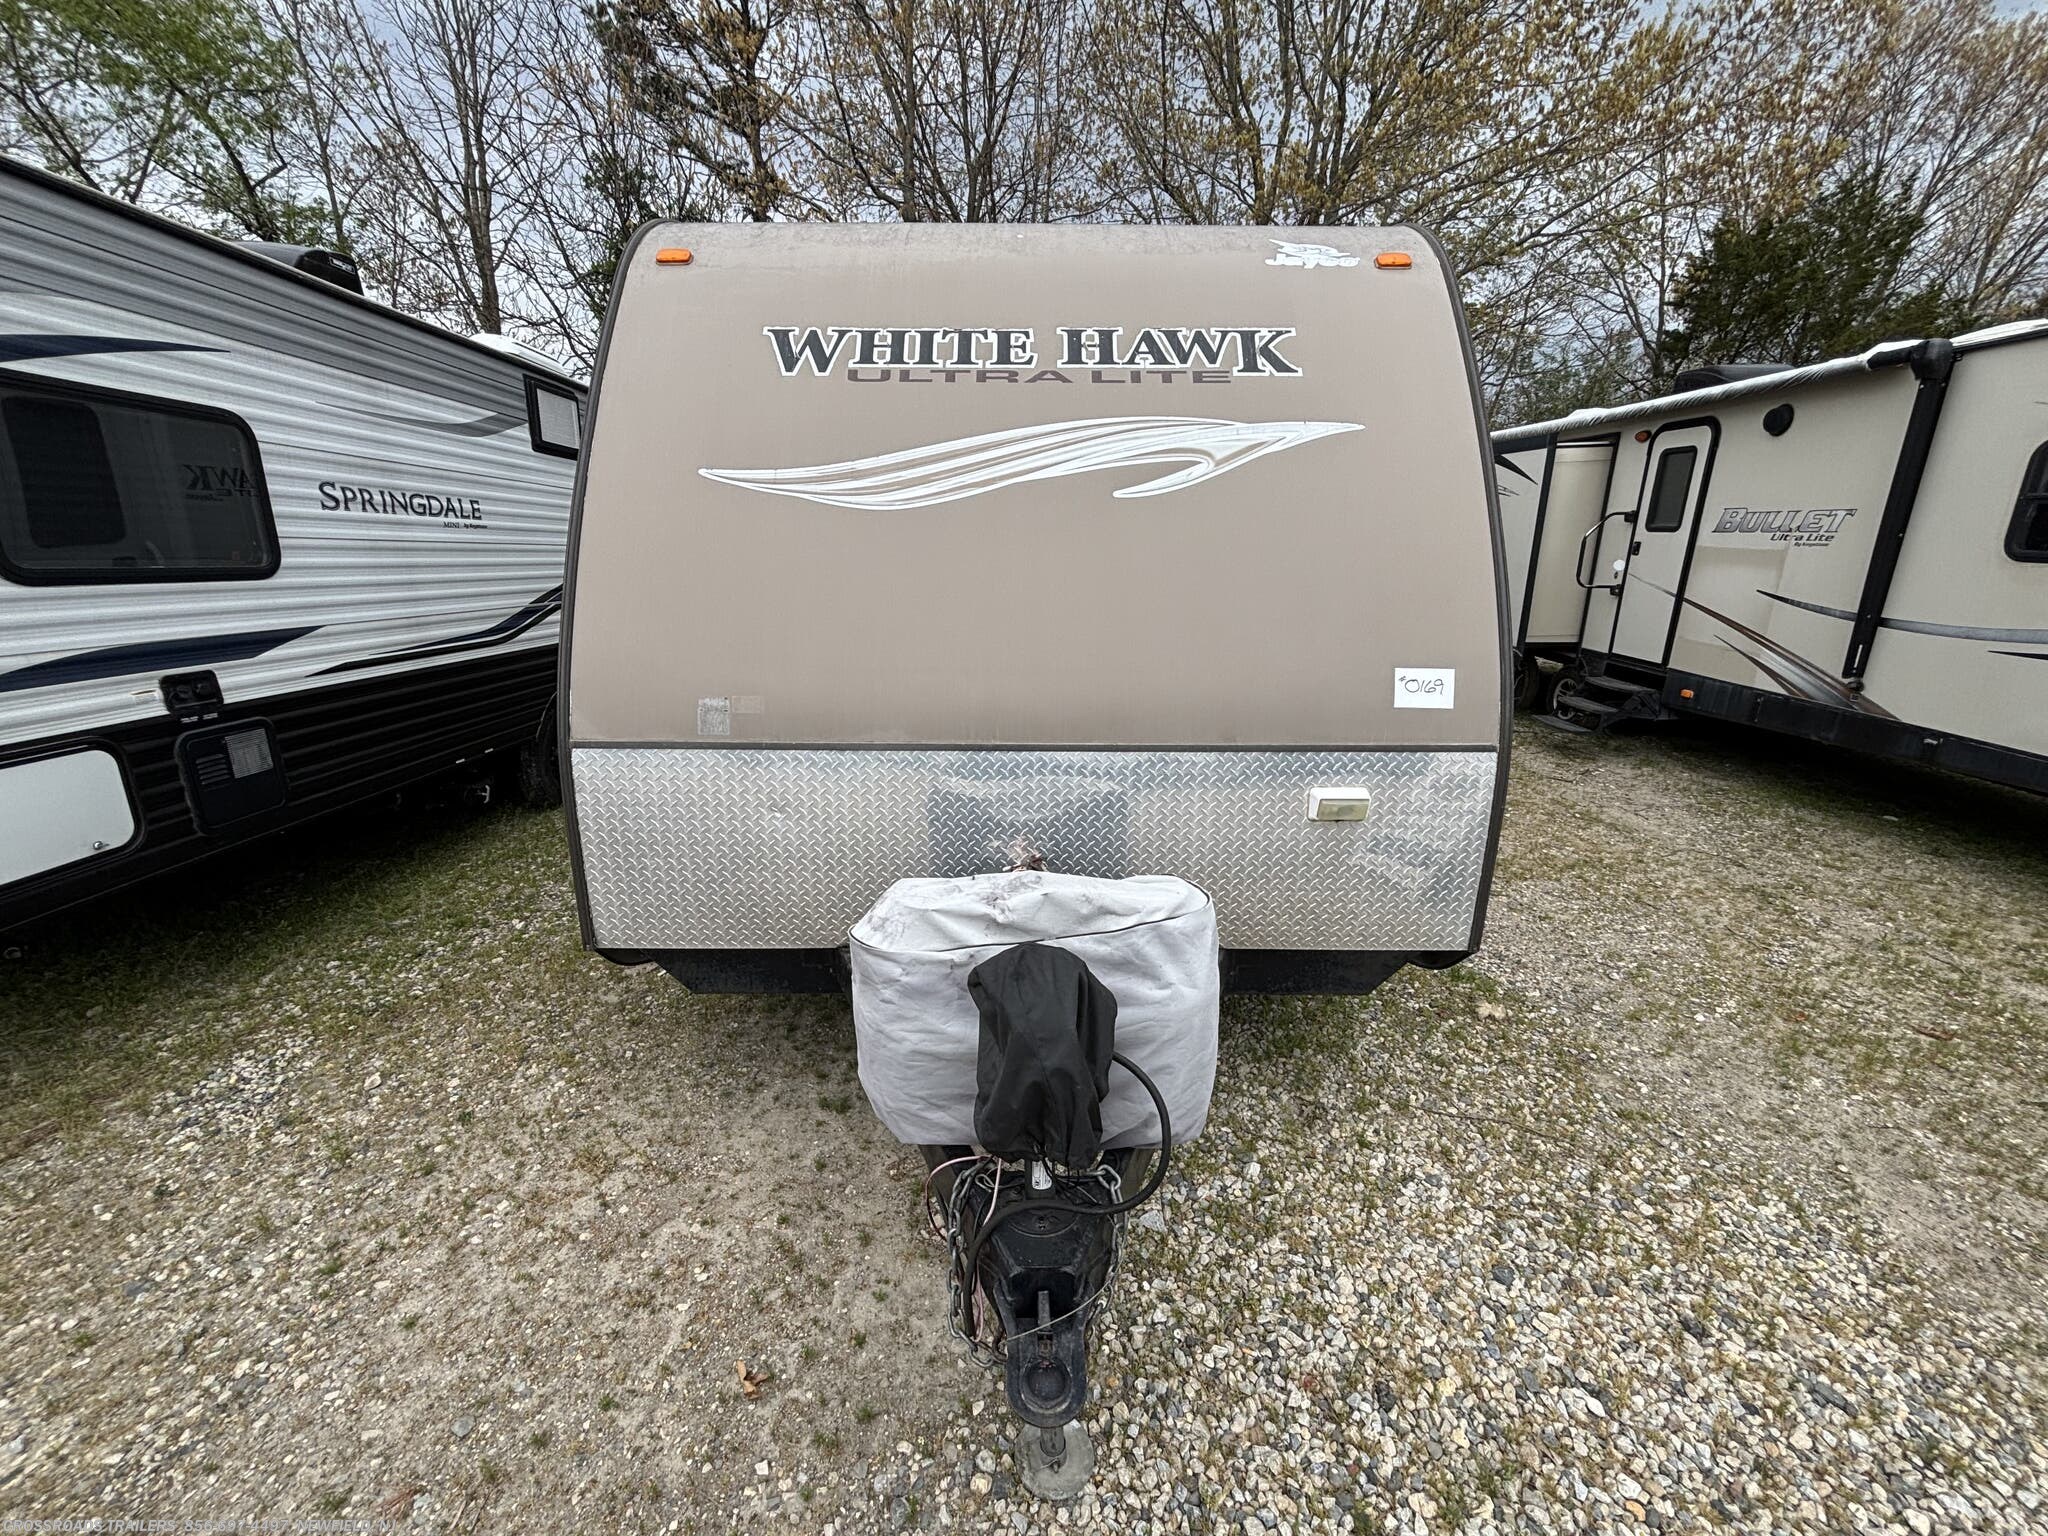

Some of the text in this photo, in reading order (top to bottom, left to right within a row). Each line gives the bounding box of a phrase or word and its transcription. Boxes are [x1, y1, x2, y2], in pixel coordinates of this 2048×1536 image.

[763, 326, 1304, 377] WHITE HAWK
[847, 369, 1232, 385] ULTRA LITE
[318, 481, 483, 521] SPRINGDALE
[1712, 507, 1858, 533] BULLET
[1806, 533, 1835, 542] Lite
